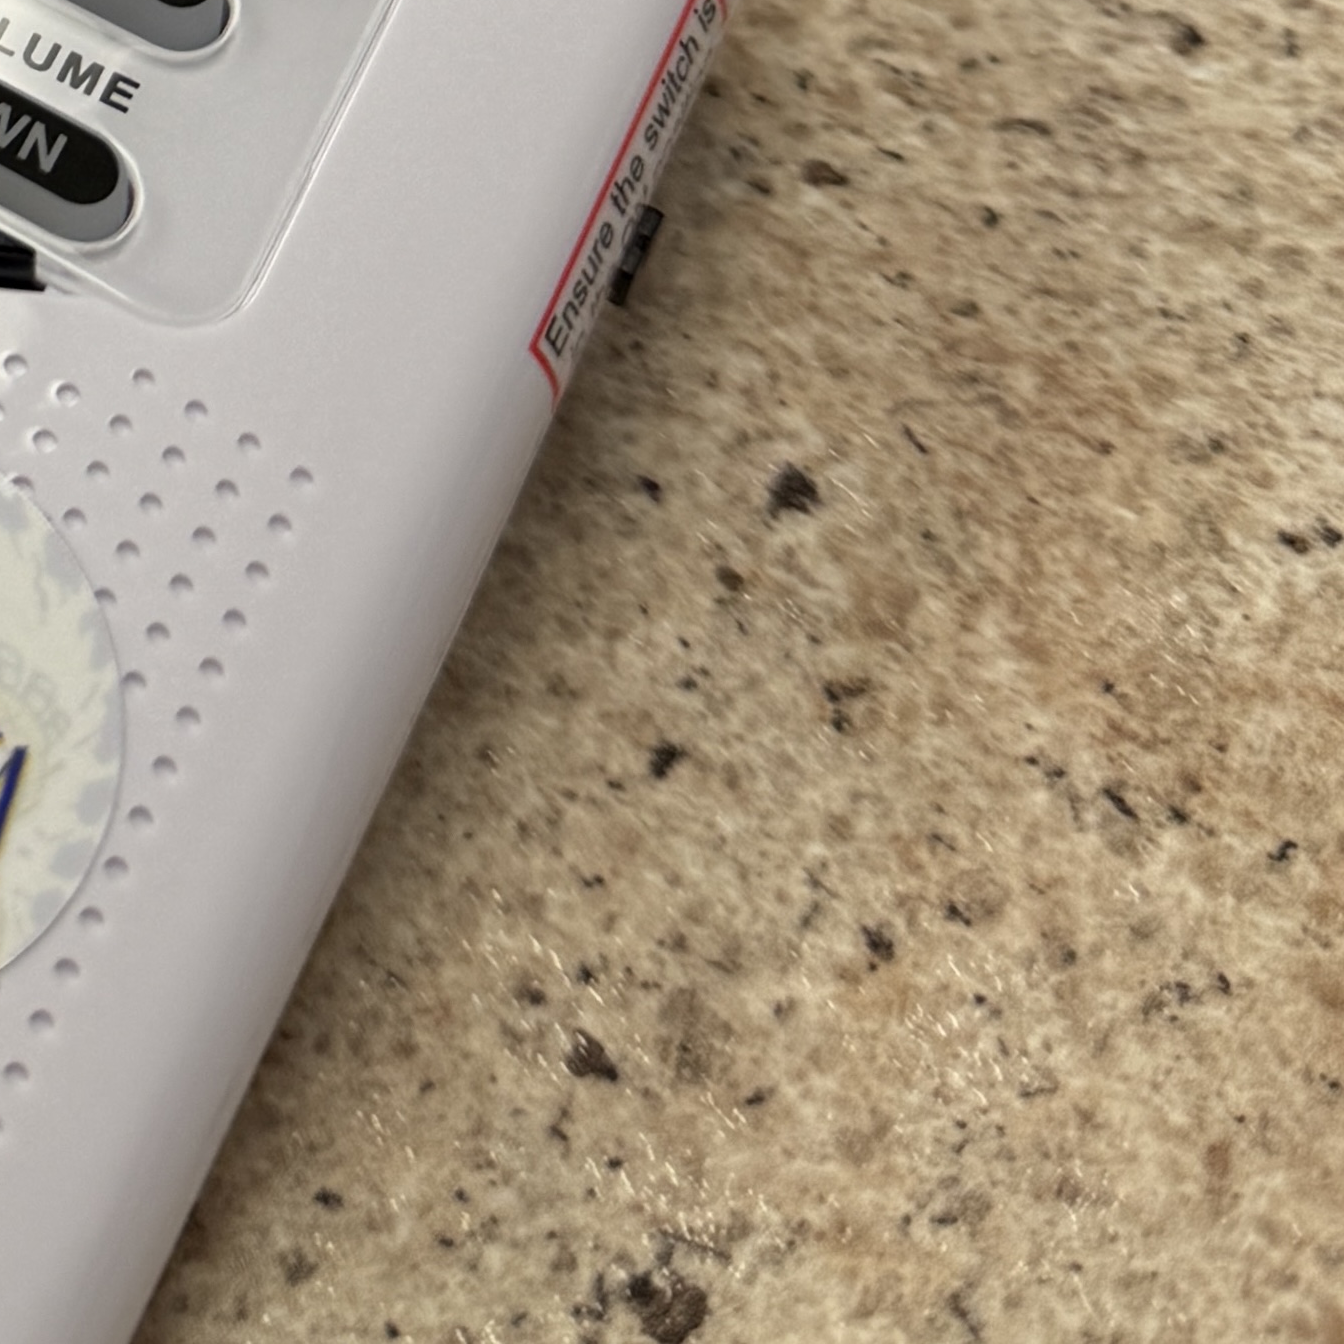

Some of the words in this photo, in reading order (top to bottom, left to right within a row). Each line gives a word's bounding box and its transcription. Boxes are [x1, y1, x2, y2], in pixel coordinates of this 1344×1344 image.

[543, 220, 616, 360] Ensure
[610, 153, 647, 221] the
[642, 33, 701, 153] switch
